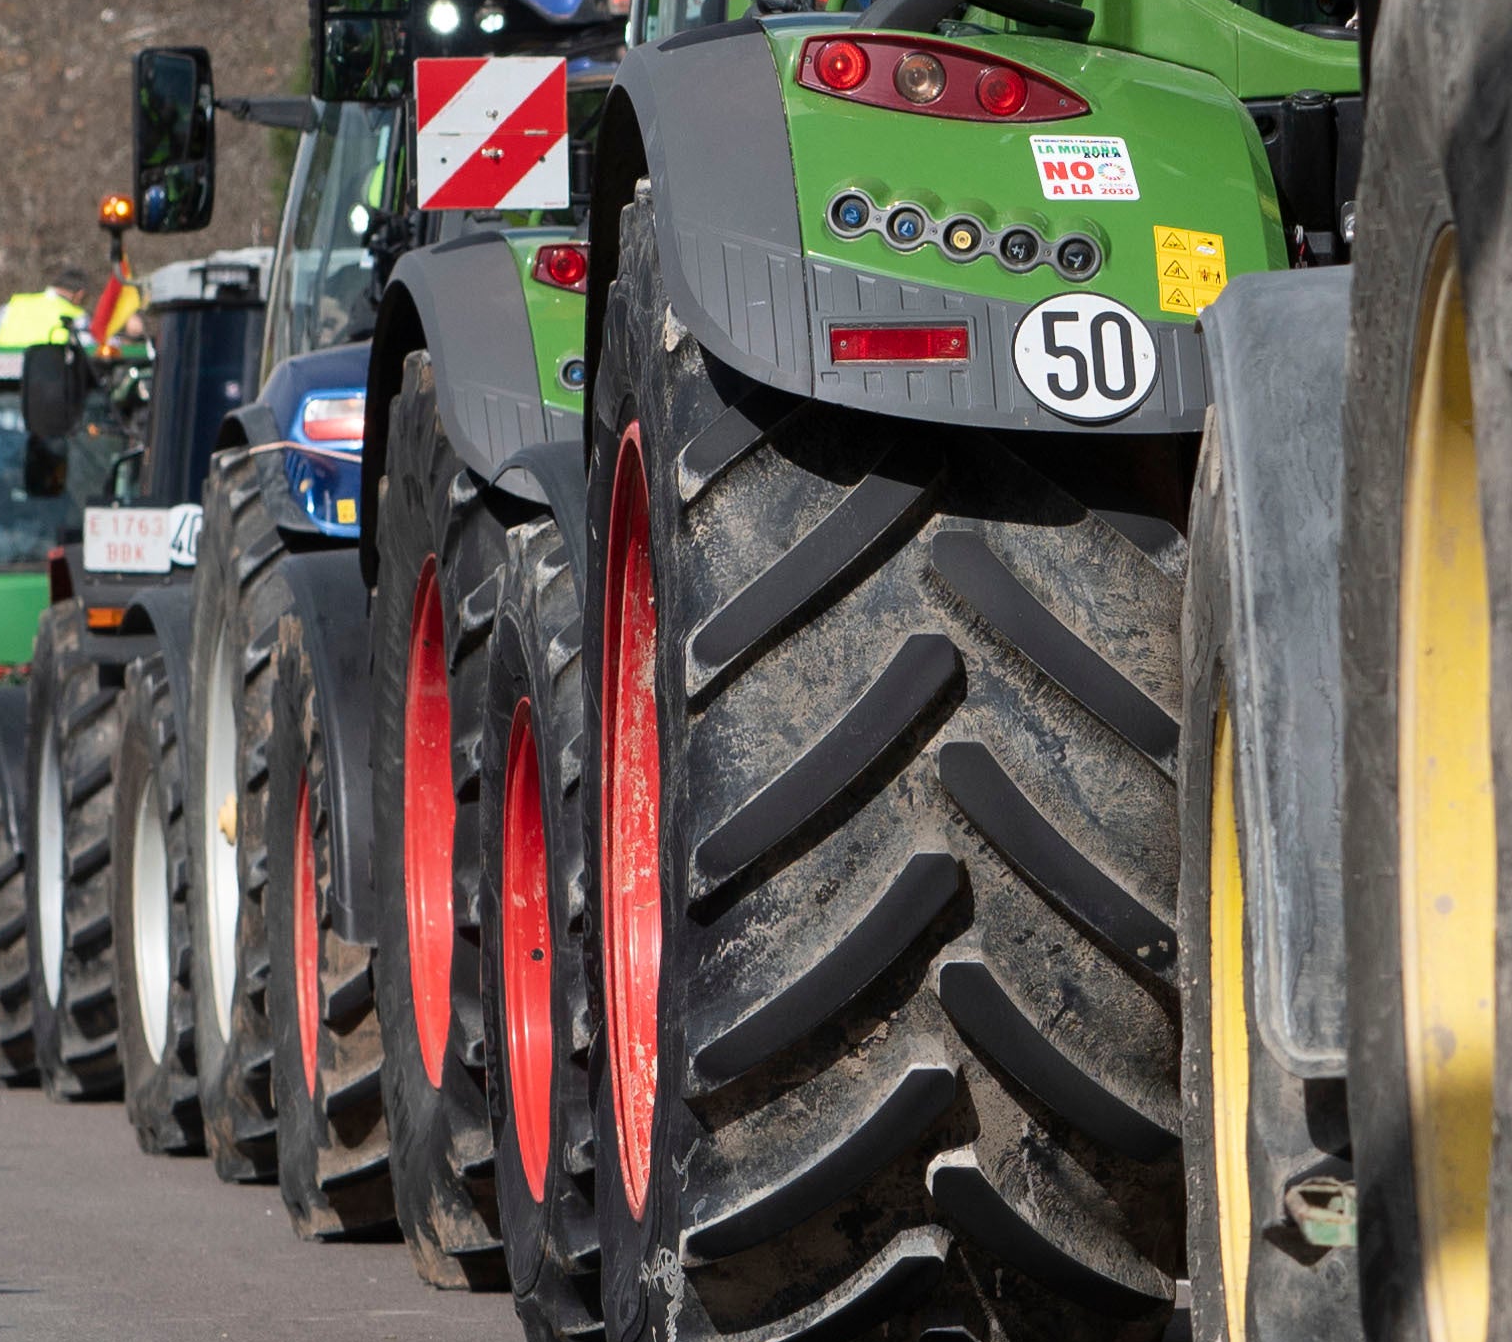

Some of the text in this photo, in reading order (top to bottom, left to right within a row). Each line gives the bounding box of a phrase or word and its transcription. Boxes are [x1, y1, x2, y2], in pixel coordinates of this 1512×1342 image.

[1037, 145, 1055, 155] LA
[1043, 161, 1095, 181] NO
[1053, 183, 1093, 195] A LA
[1042, 311, 1137, 401] 50
[90, 516, 100, 537] E
